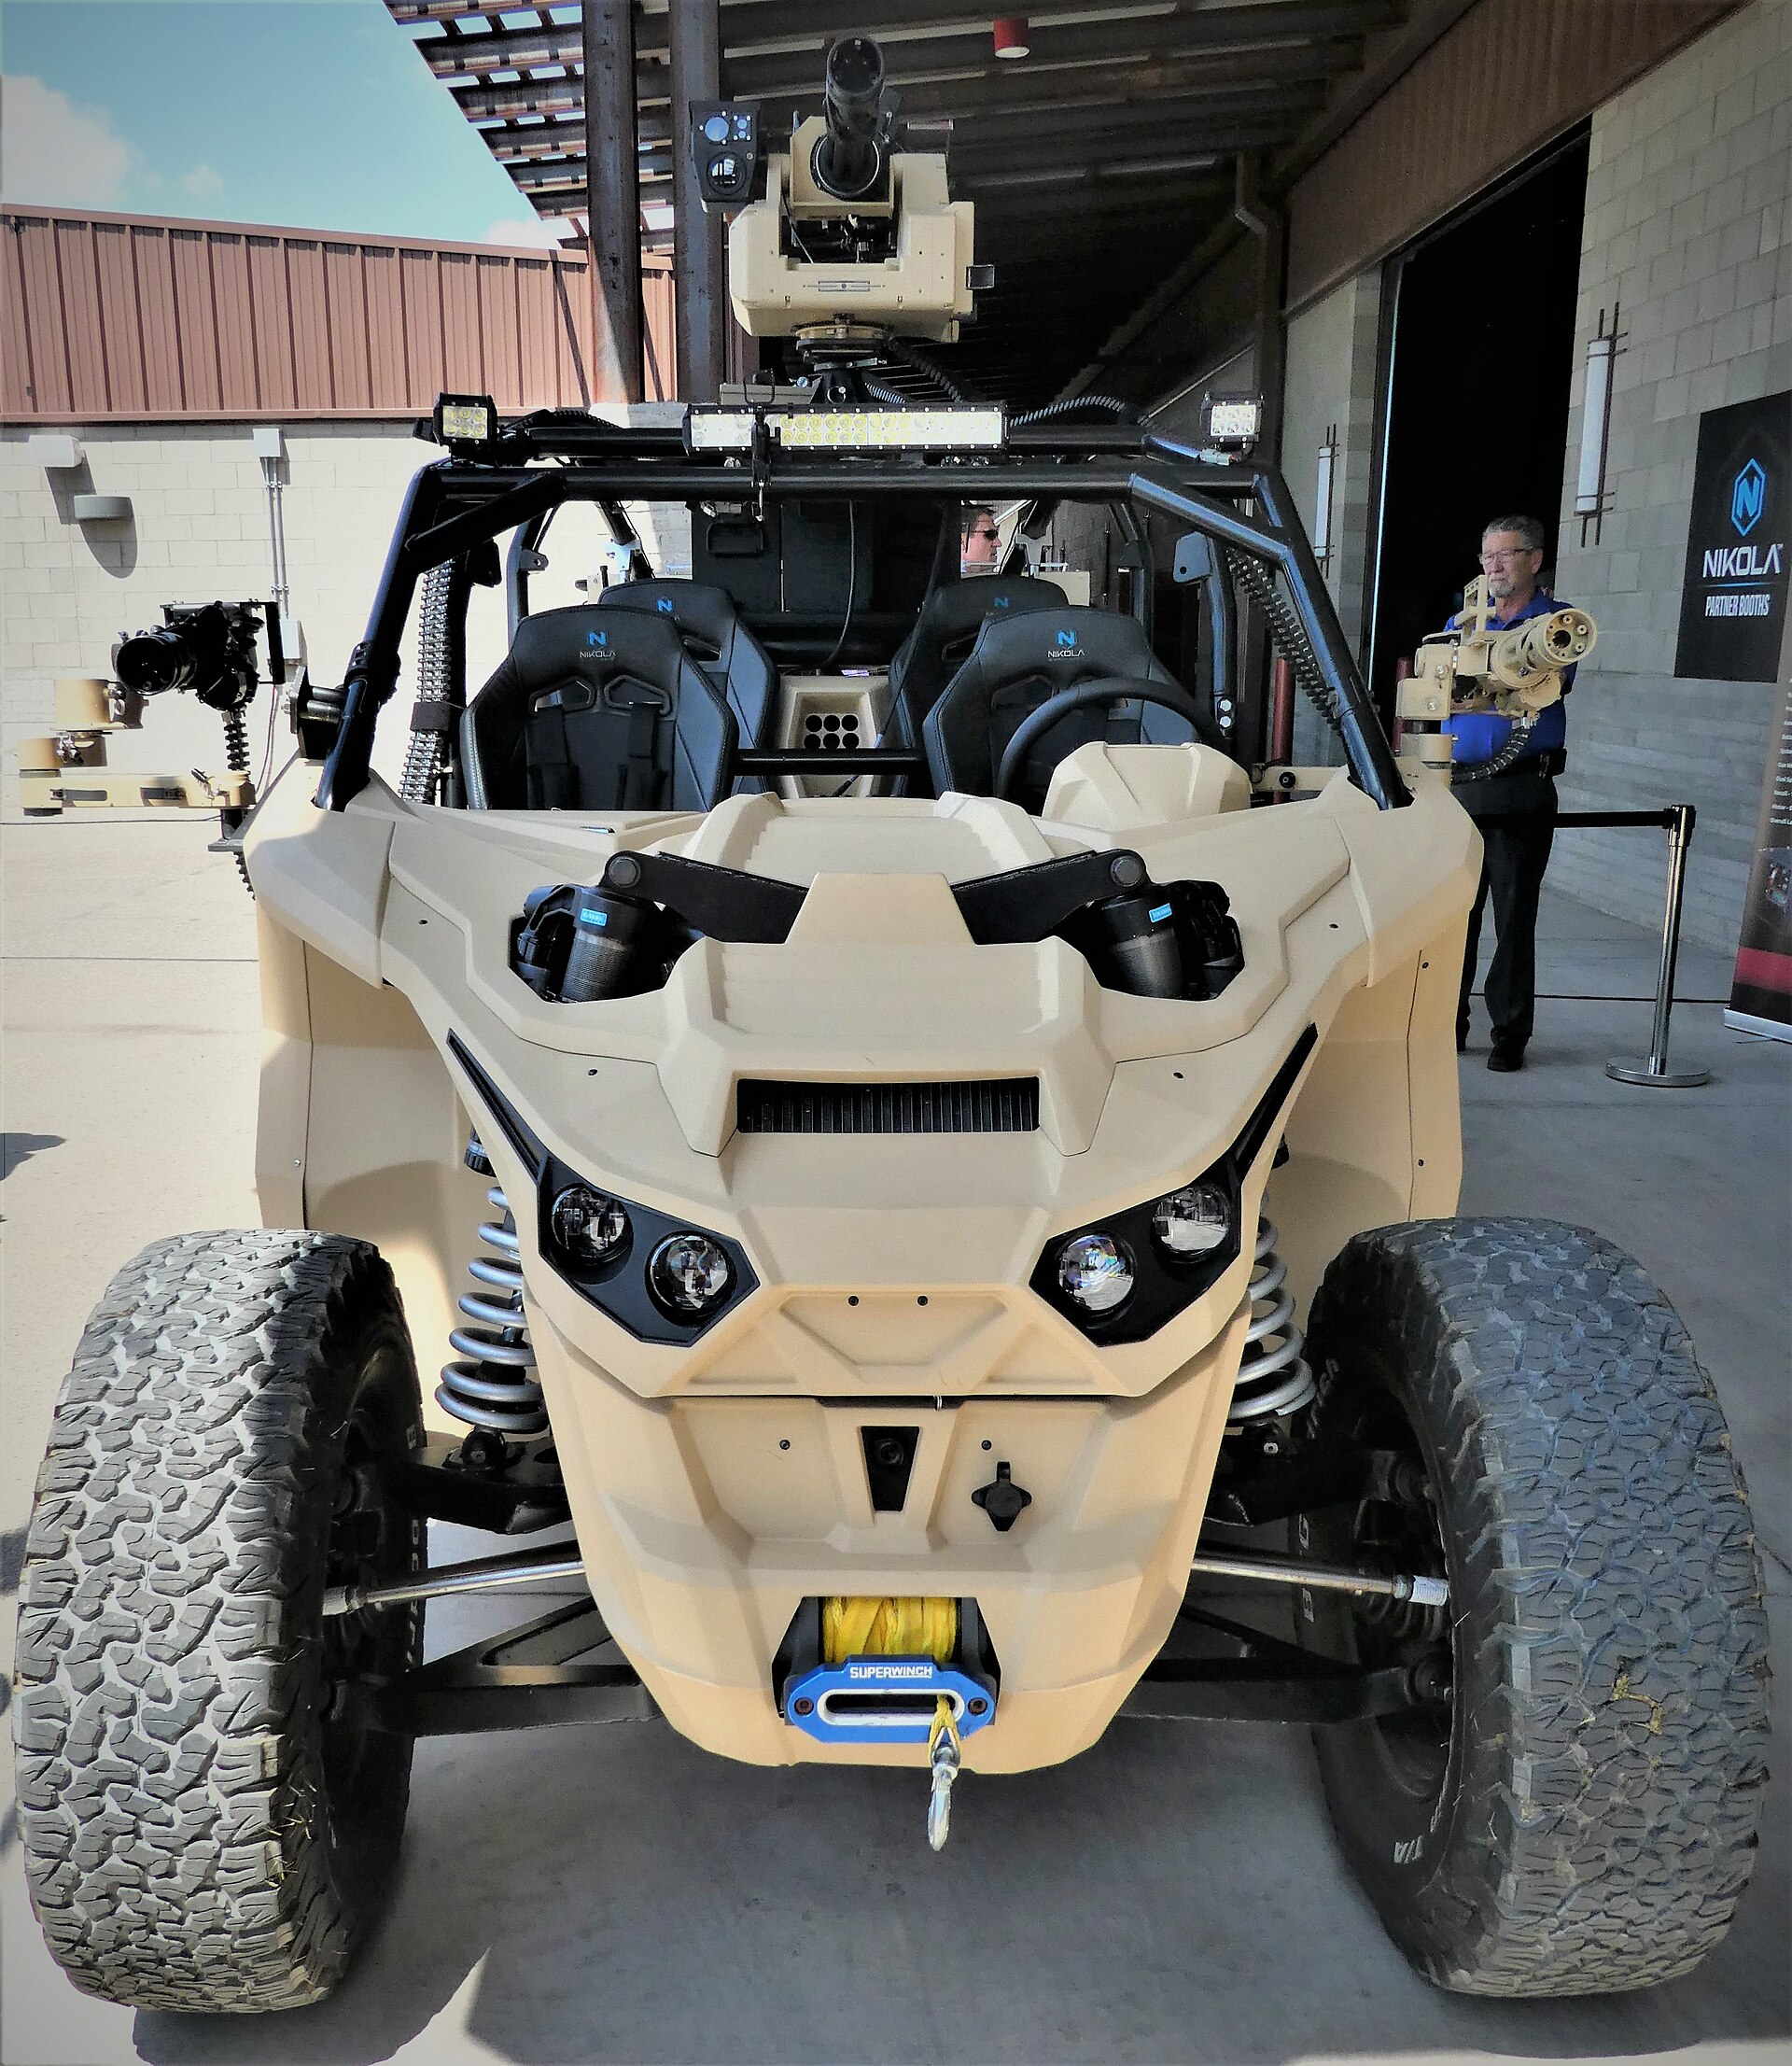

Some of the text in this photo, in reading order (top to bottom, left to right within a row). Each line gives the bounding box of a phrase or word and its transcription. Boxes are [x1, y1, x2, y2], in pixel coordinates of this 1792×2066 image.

[1702, 544, 1781, 578] NIKOLA
[1705, 594, 1770, 616] PARTNER BOOTHS
[579, 650, 617, 659] NIKOLA
[1047, 649, 1085, 658] NIKOLA
[849, 1666, 932, 1679] SUPERWINCH
